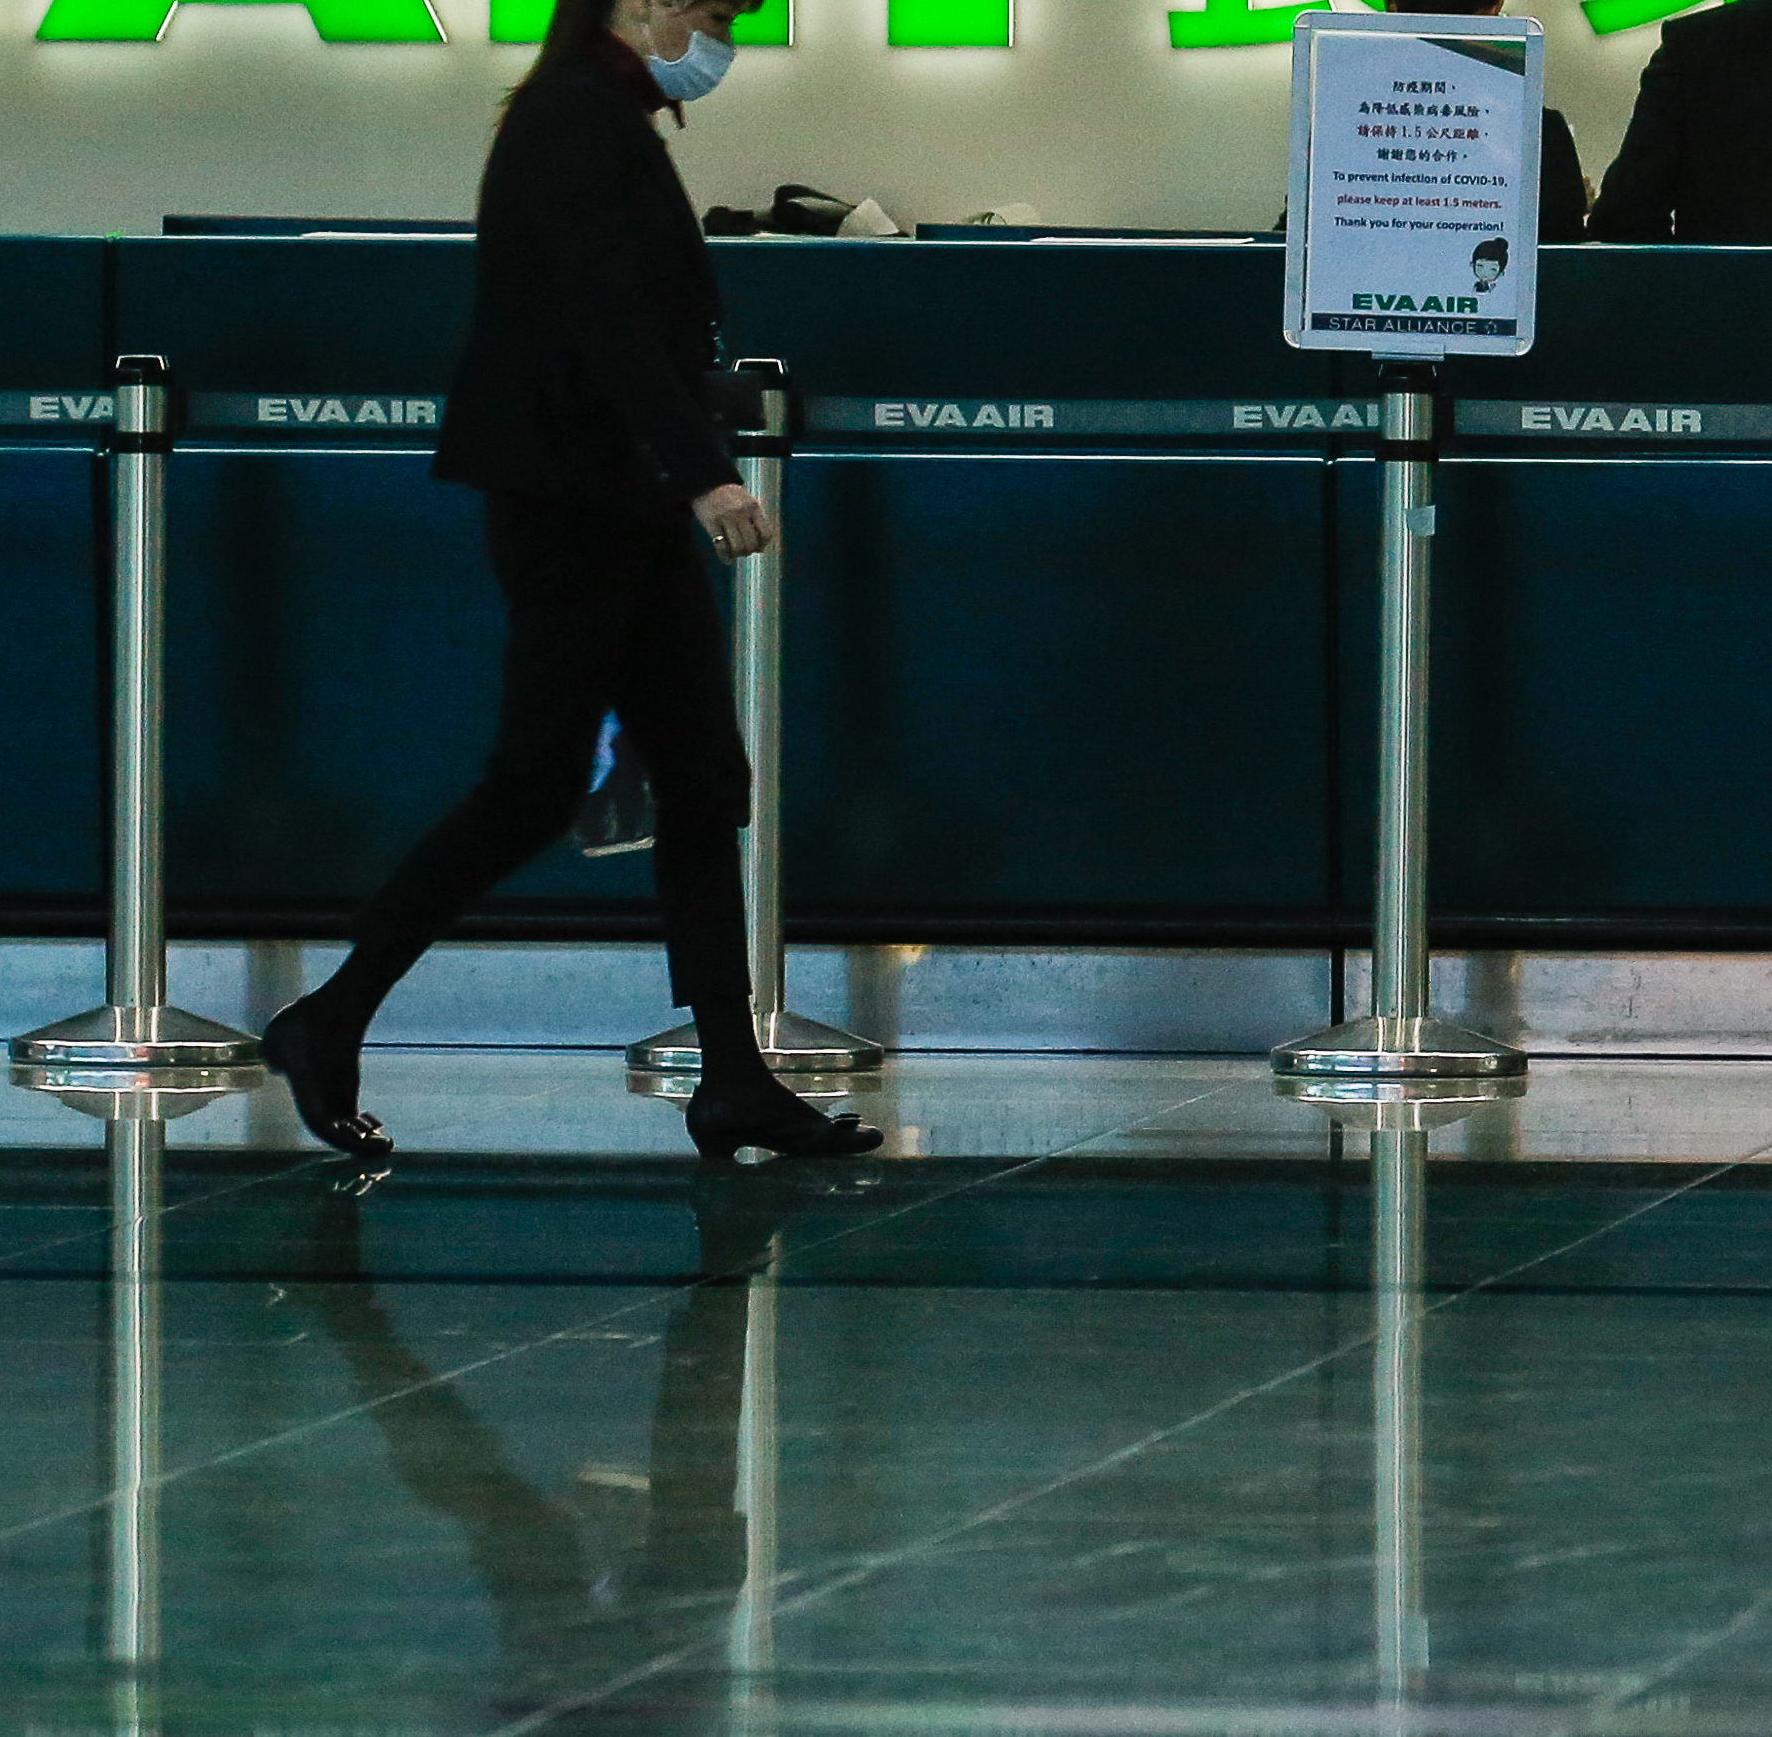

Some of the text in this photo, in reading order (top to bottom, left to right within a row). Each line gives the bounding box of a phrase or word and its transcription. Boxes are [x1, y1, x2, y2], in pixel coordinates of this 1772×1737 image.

[1333, 171, 1507, 187] To prevent infection of COVID-19,
[1337, 194, 1501, 208] please keep at least 1.5 meters.
[1335, 217, 1503, 231] Thank you for your cooperation!
[1329, 316, 1478, 335] STAR ALLIANCE
